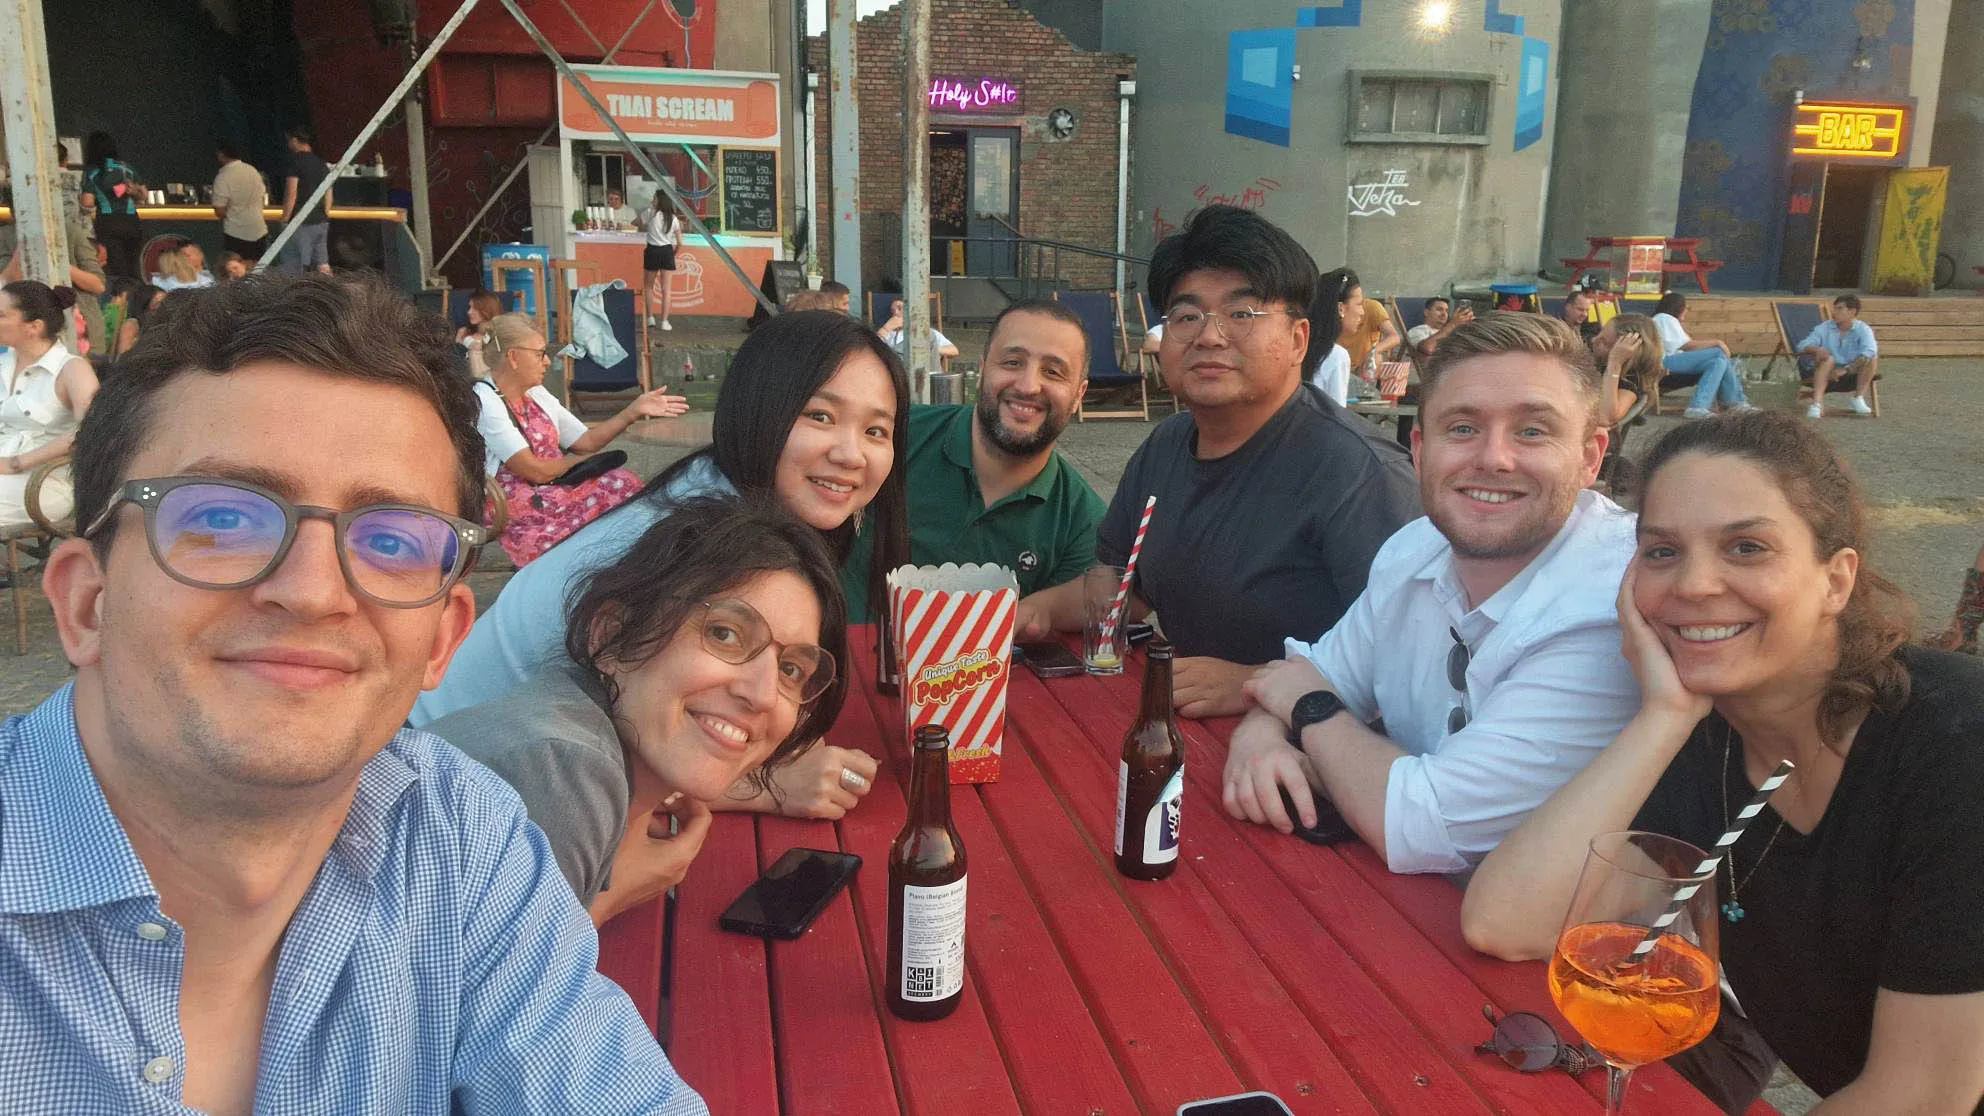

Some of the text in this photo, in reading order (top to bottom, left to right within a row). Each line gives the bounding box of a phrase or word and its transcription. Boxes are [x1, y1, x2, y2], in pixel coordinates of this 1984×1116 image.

[606, 94, 734, 122] THAI SCREAM
[928, 79, 972, 110] Holy
[1816, 112, 1877, 150] BAR
[915, 659, 1002, 704] PopCorn
[924, 651, 988, 682] Unique Taste
